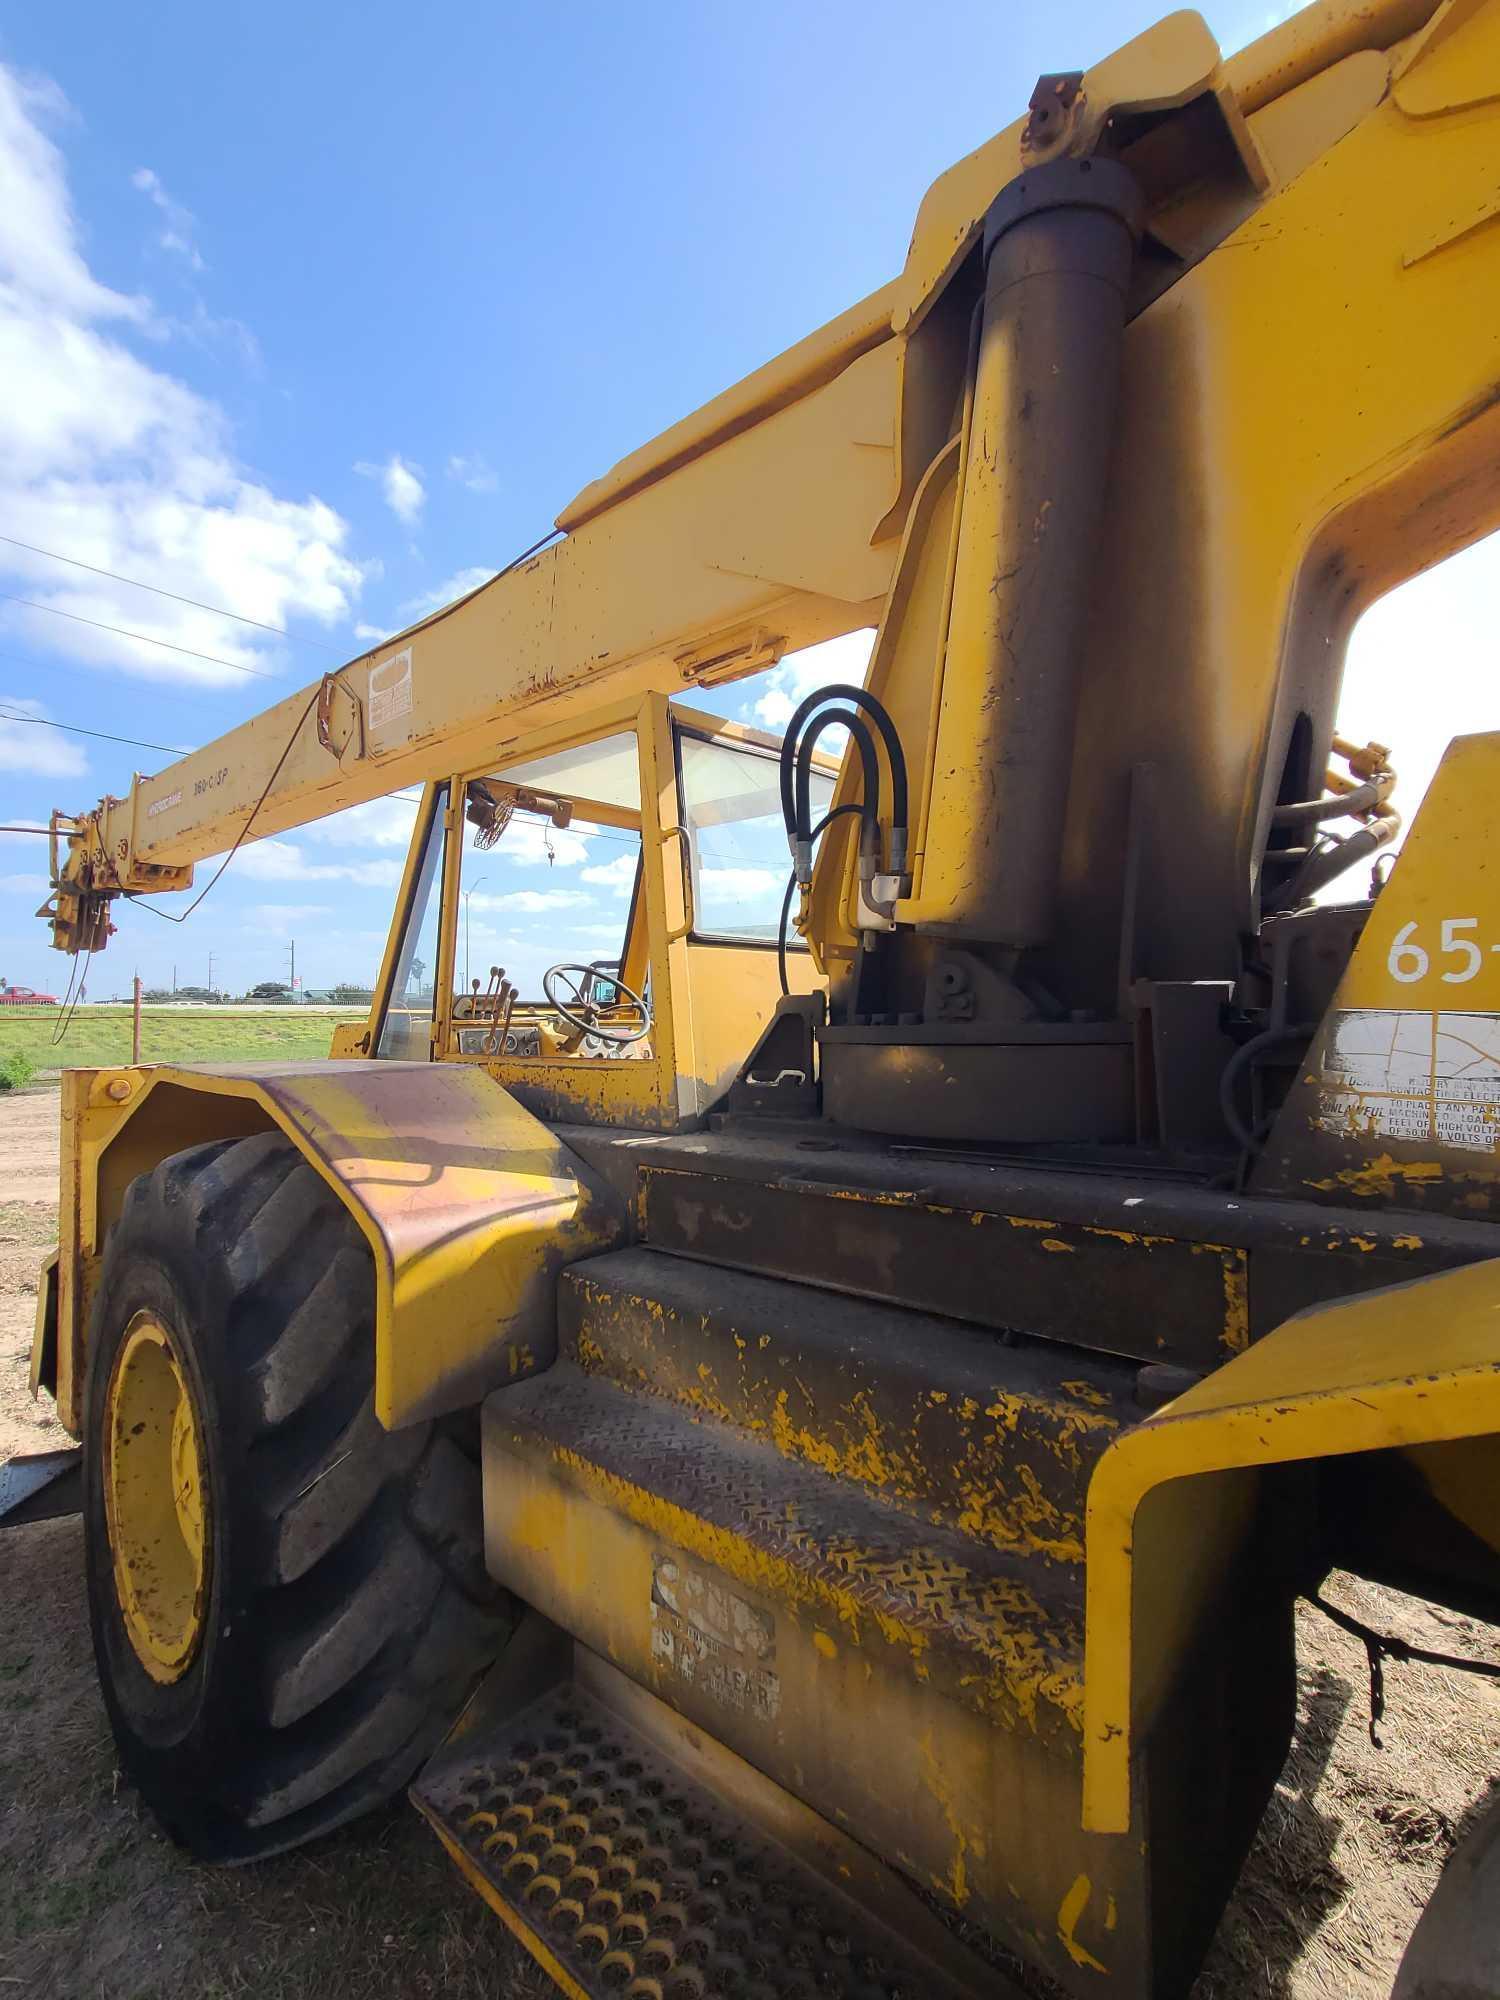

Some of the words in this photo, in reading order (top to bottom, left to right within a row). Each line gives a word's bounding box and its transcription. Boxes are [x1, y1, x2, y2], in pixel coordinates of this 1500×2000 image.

[1406, 1100, 1441, 1110] PLACE
[1445, 1104, 1467, 1113] ANY
[1417, 1120, 1430, 1129] OF
[1438, 1122, 1462, 1132] HIGH
[1389, 1126, 1401, 1135] OF
[1447, 1131, 1481, 1143] VOLTS
